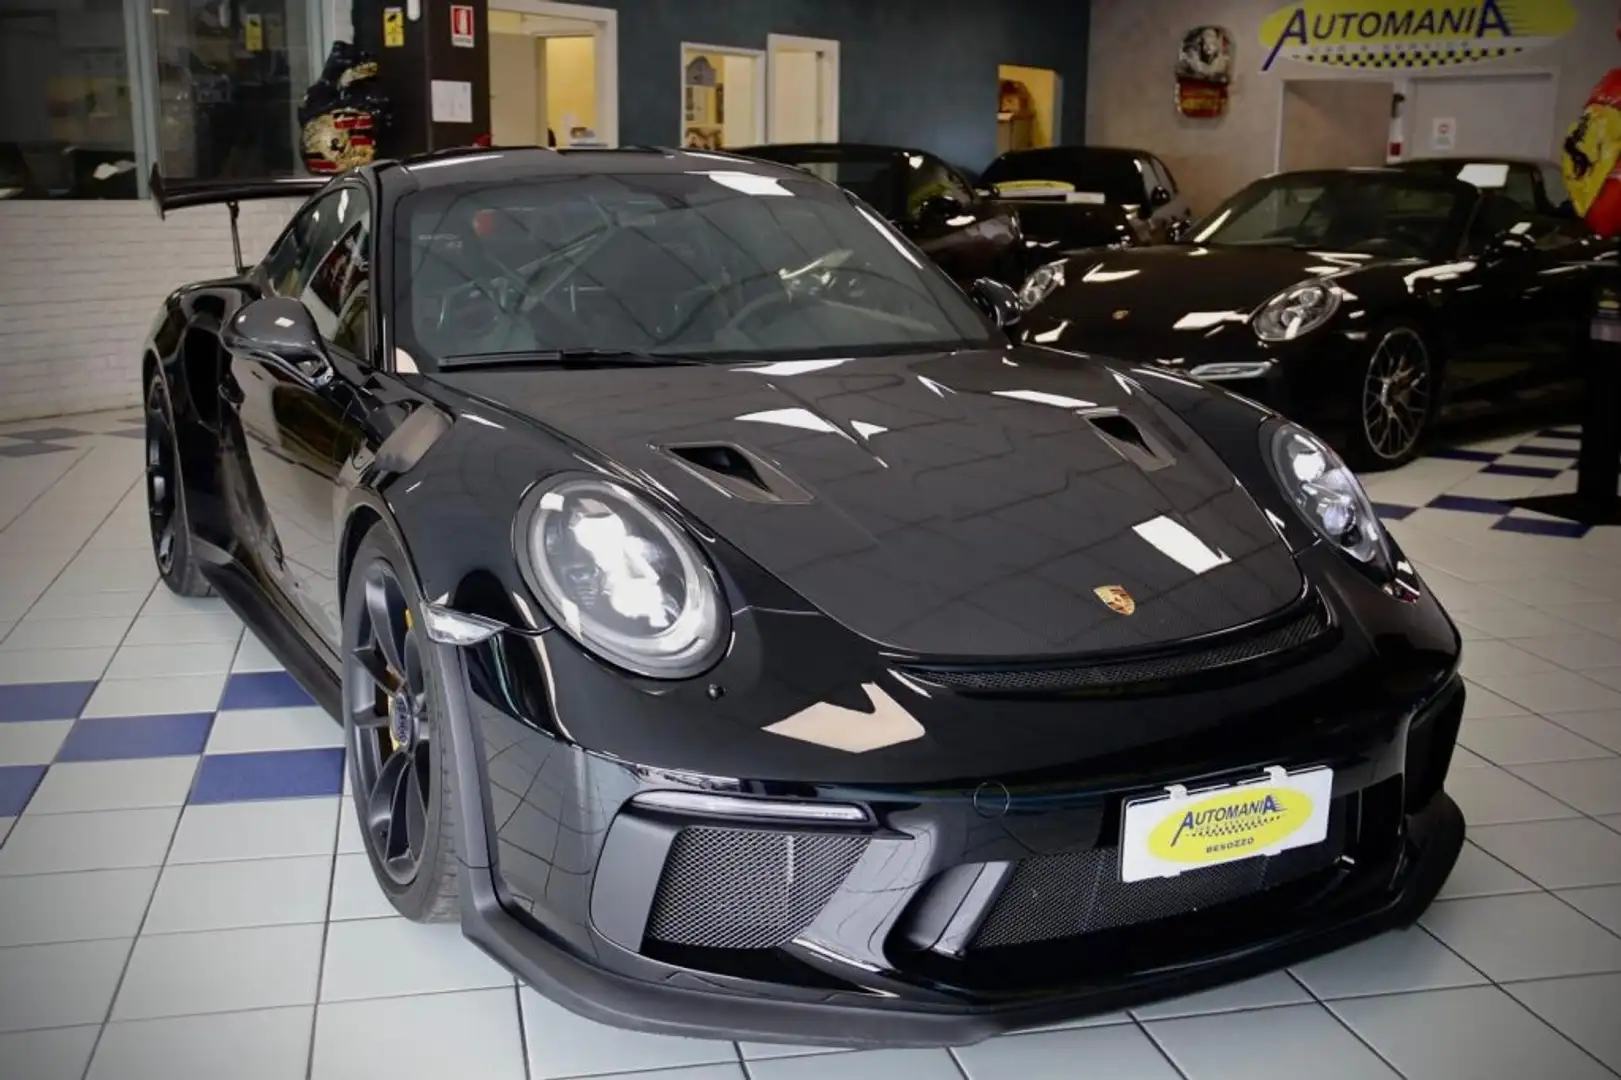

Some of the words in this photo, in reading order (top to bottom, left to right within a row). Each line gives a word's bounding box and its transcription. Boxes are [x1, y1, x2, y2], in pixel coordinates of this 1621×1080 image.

[1262, 0, 1511, 71] AUTOMANIA
[1171, 795, 1277, 846] AUTOMANIA
[1206, 837, 1255, 853] BESOZZO
